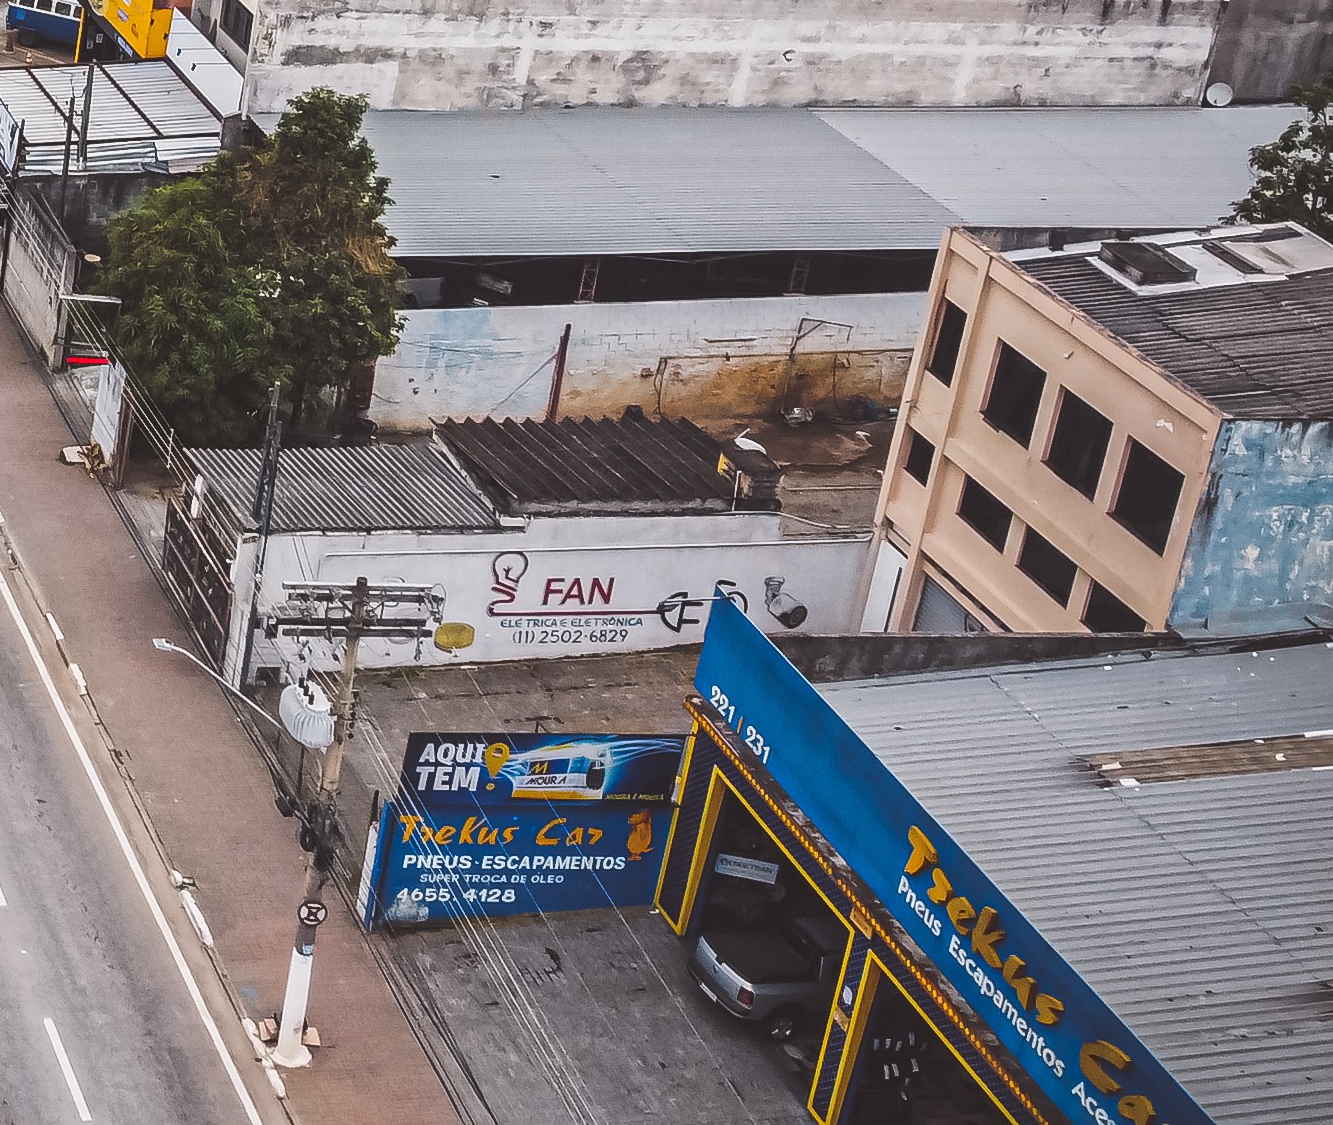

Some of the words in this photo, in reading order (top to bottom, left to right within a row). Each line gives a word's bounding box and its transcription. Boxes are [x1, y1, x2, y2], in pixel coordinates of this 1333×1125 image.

[541, 577, 616, 606] FAN
[538, 629, 629, 644] 2502-6829
[710, 685, 736, 723] 221
[745, 726, 770, 764] 231
[419, 743, 485, 763] AQUI
[416, 766, 480, 792] TEM
[526, 776, 568, 786] MOURA
[403, 855, 472, 870] PNEUS
[482, 855, 626, 870] ESCAPAMENTOS
[420, 873, 459, 883] SUPER
[464, 874, 507, 883] TROCA
[510, 874, 527, 883] DE
[897, 874, 942, 936] Pneus
[949, 934, 1066, 1078] Escapamentos
